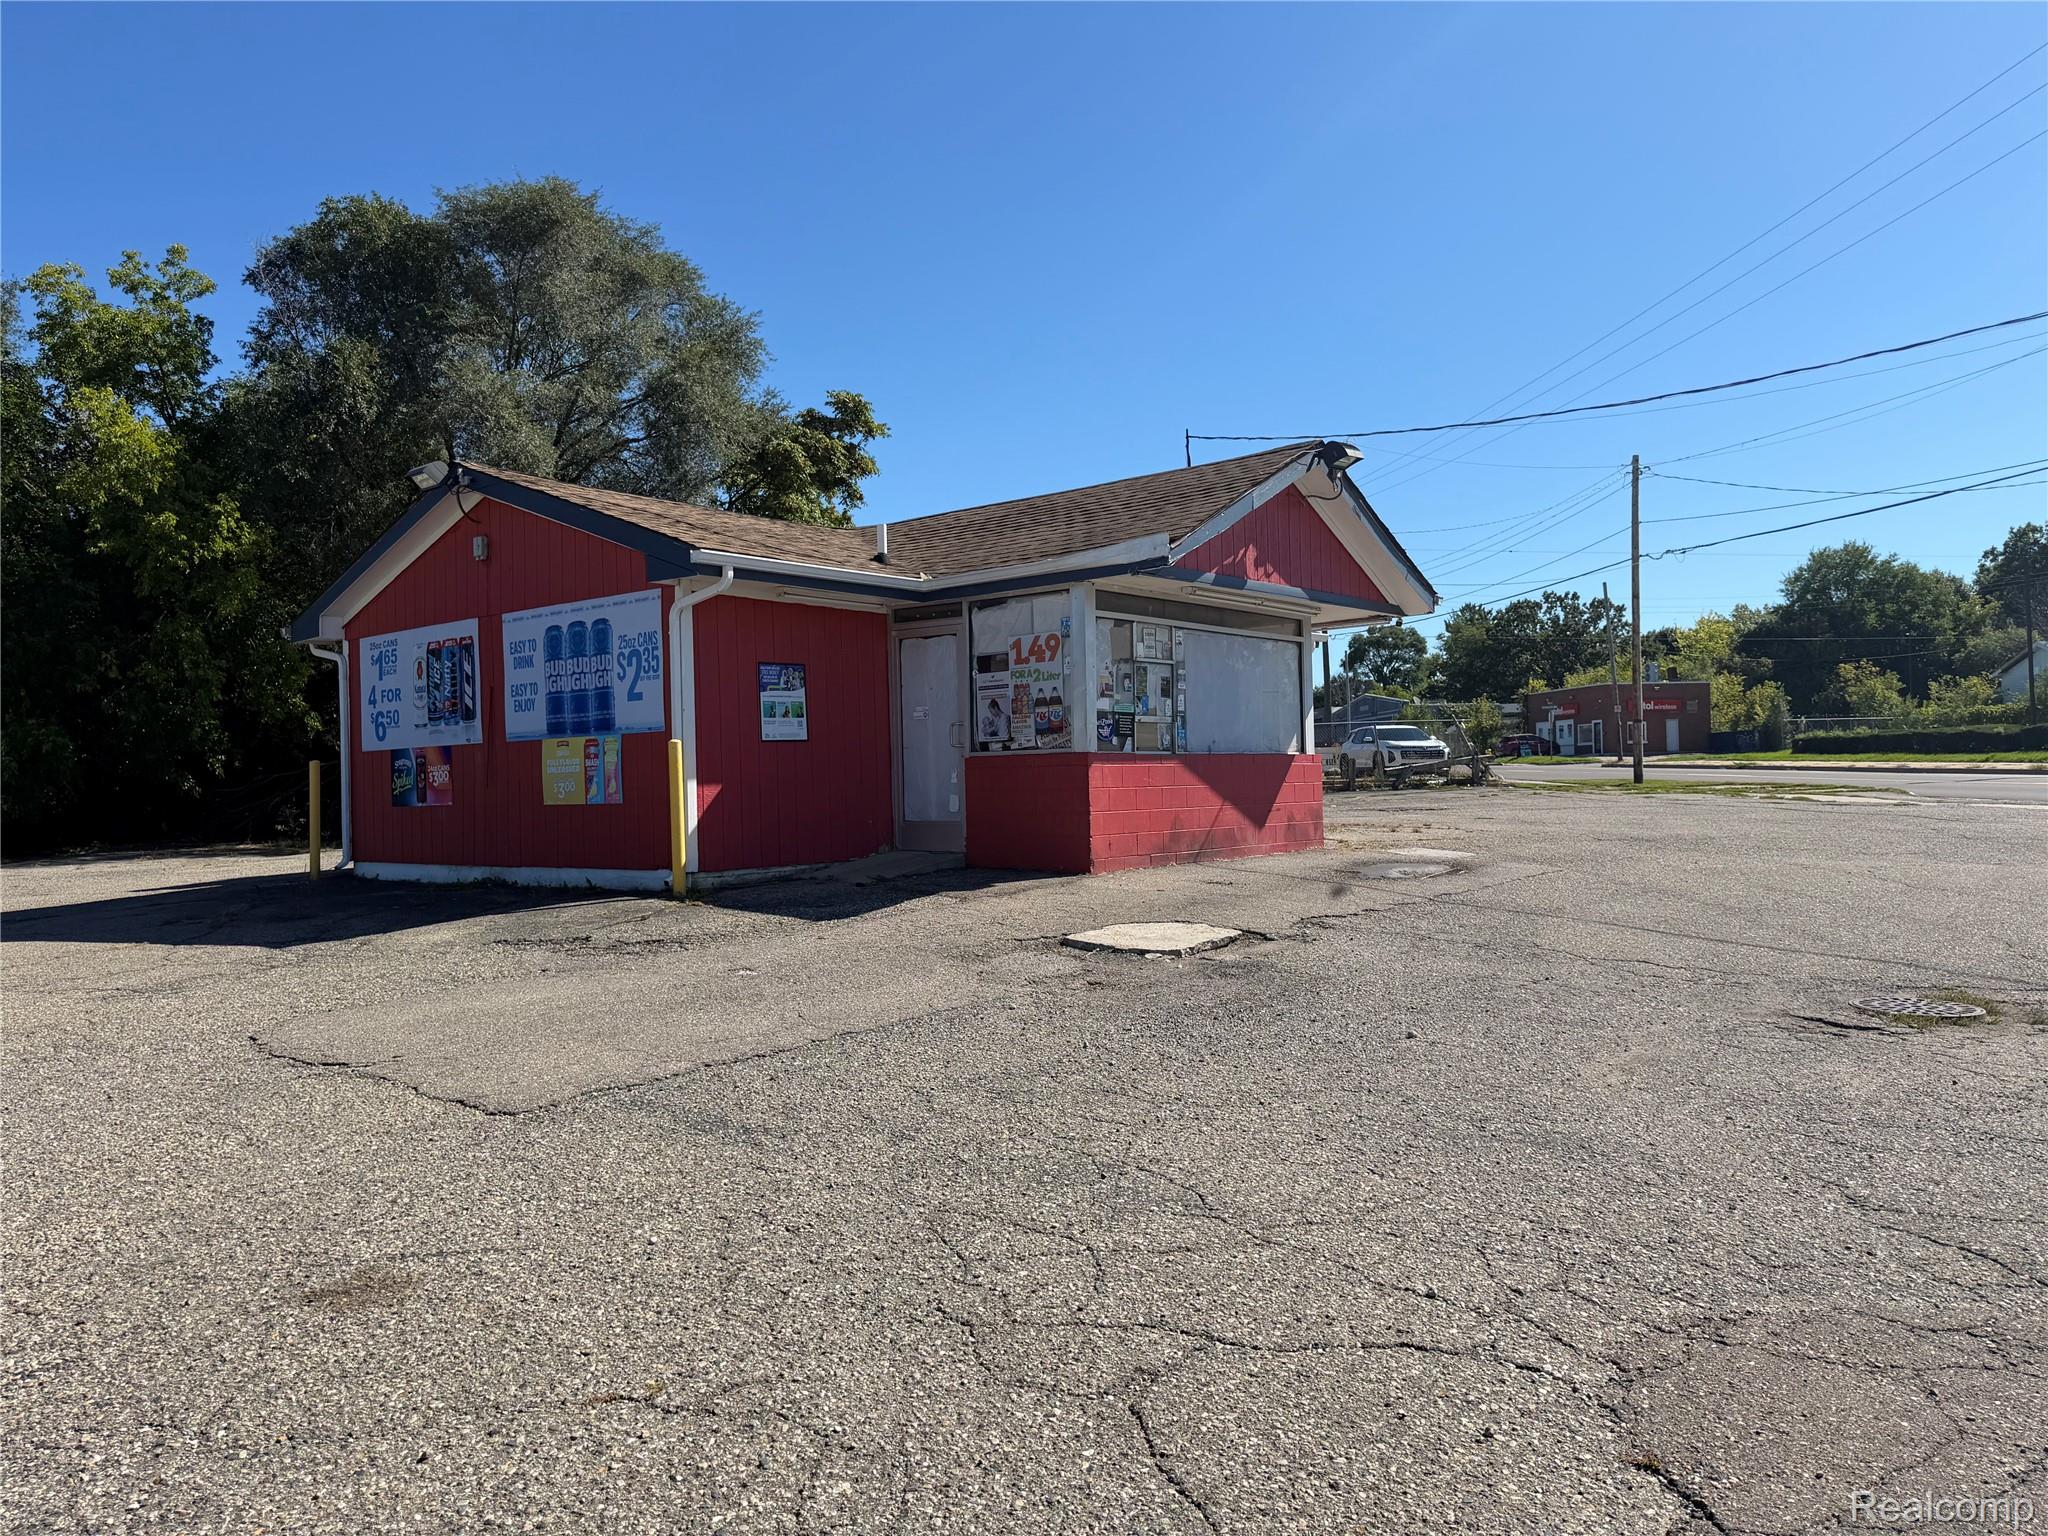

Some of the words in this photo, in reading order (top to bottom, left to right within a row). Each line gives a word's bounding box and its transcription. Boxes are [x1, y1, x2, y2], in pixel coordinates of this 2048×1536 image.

[383, 638, 398, 648] CANS
[510, 640, 527, 655] EASY
[528, 639, 537, 652] TO
[618, 634, 637, 650] 25oz
[638, 630, 658, 647] CANS
[513, 655, 534, 669] DRINK
[545, 660, 566, 677] BUD
[566, 656, 590, 675] BUD
[590, 654, 612, 673] BUD
[383, 667, 398, 677] EACH
[1011, 669, 1026, 680] FOR
[1033, 668, 1042, 682] 2
[1042, 670, 1062, 681] Liter
[511, 683, 528, 697] EASY
[529, 682, 538, 696] TO
[368, 685, 377, 709] 4
[381, 688, 402, 703] FOR
[514, 698, 536, 712] ENJOY
